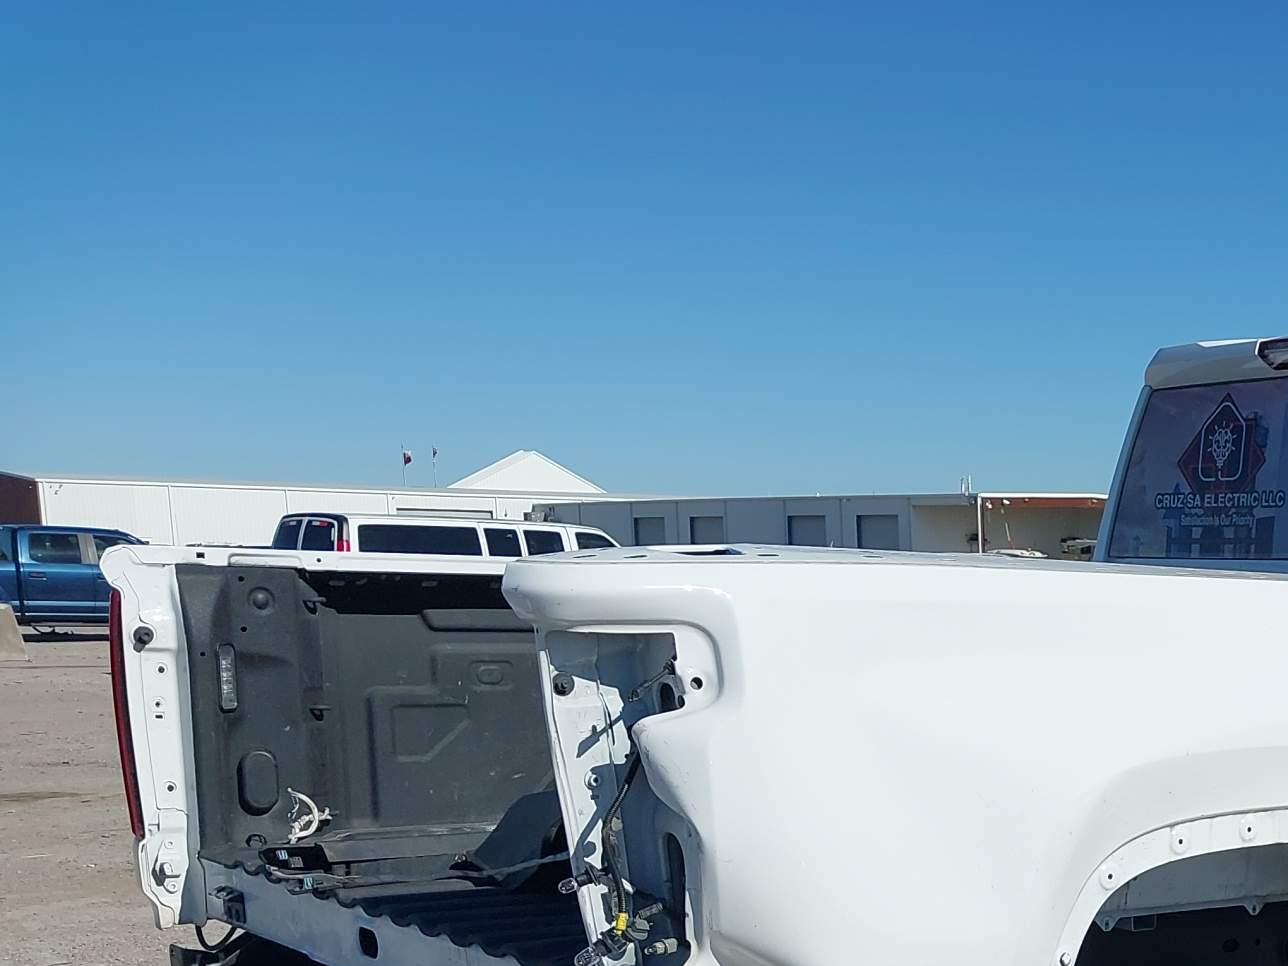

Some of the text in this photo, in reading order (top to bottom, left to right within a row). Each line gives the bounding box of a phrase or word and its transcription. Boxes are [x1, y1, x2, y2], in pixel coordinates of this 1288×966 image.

[1155, 491, 1285, 508] CRUZ SA ELECTRIC LLC
